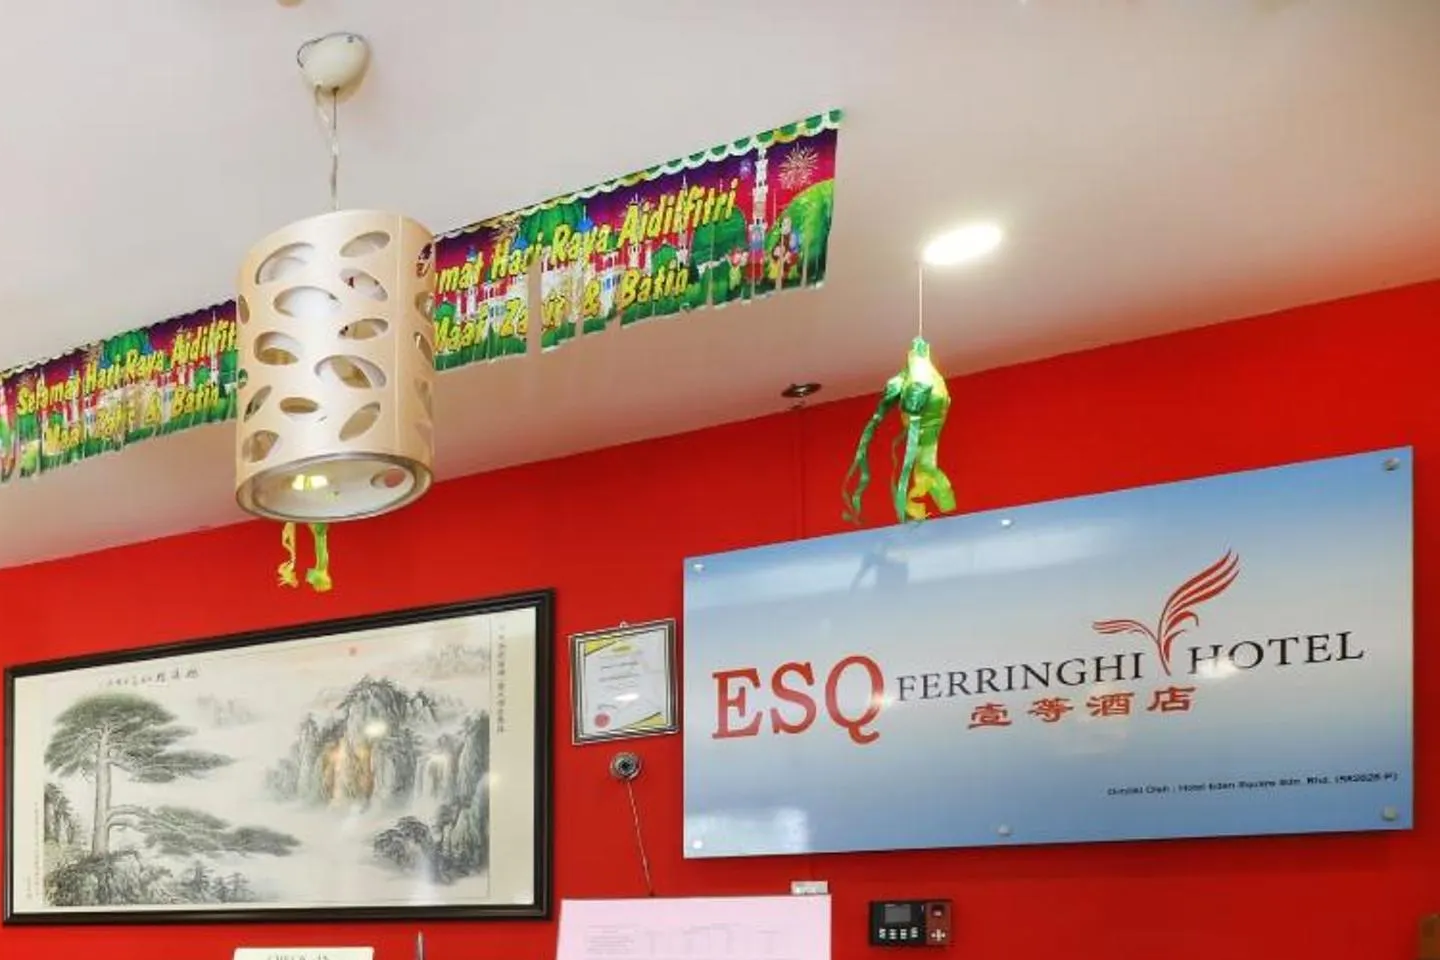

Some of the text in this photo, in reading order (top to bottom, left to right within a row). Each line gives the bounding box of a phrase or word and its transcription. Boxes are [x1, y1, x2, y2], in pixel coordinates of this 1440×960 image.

[491, 232, 544, 280] Hari
[551, 222, 611, 272] Raya
[617, 177, 739, 249] Aidilfitri
[620, 263, 689, 309] Batin
[85, 359, 121, 393] Hari
[712, 631, 1365, 745] ESQ FERRINGHI HOTEL
